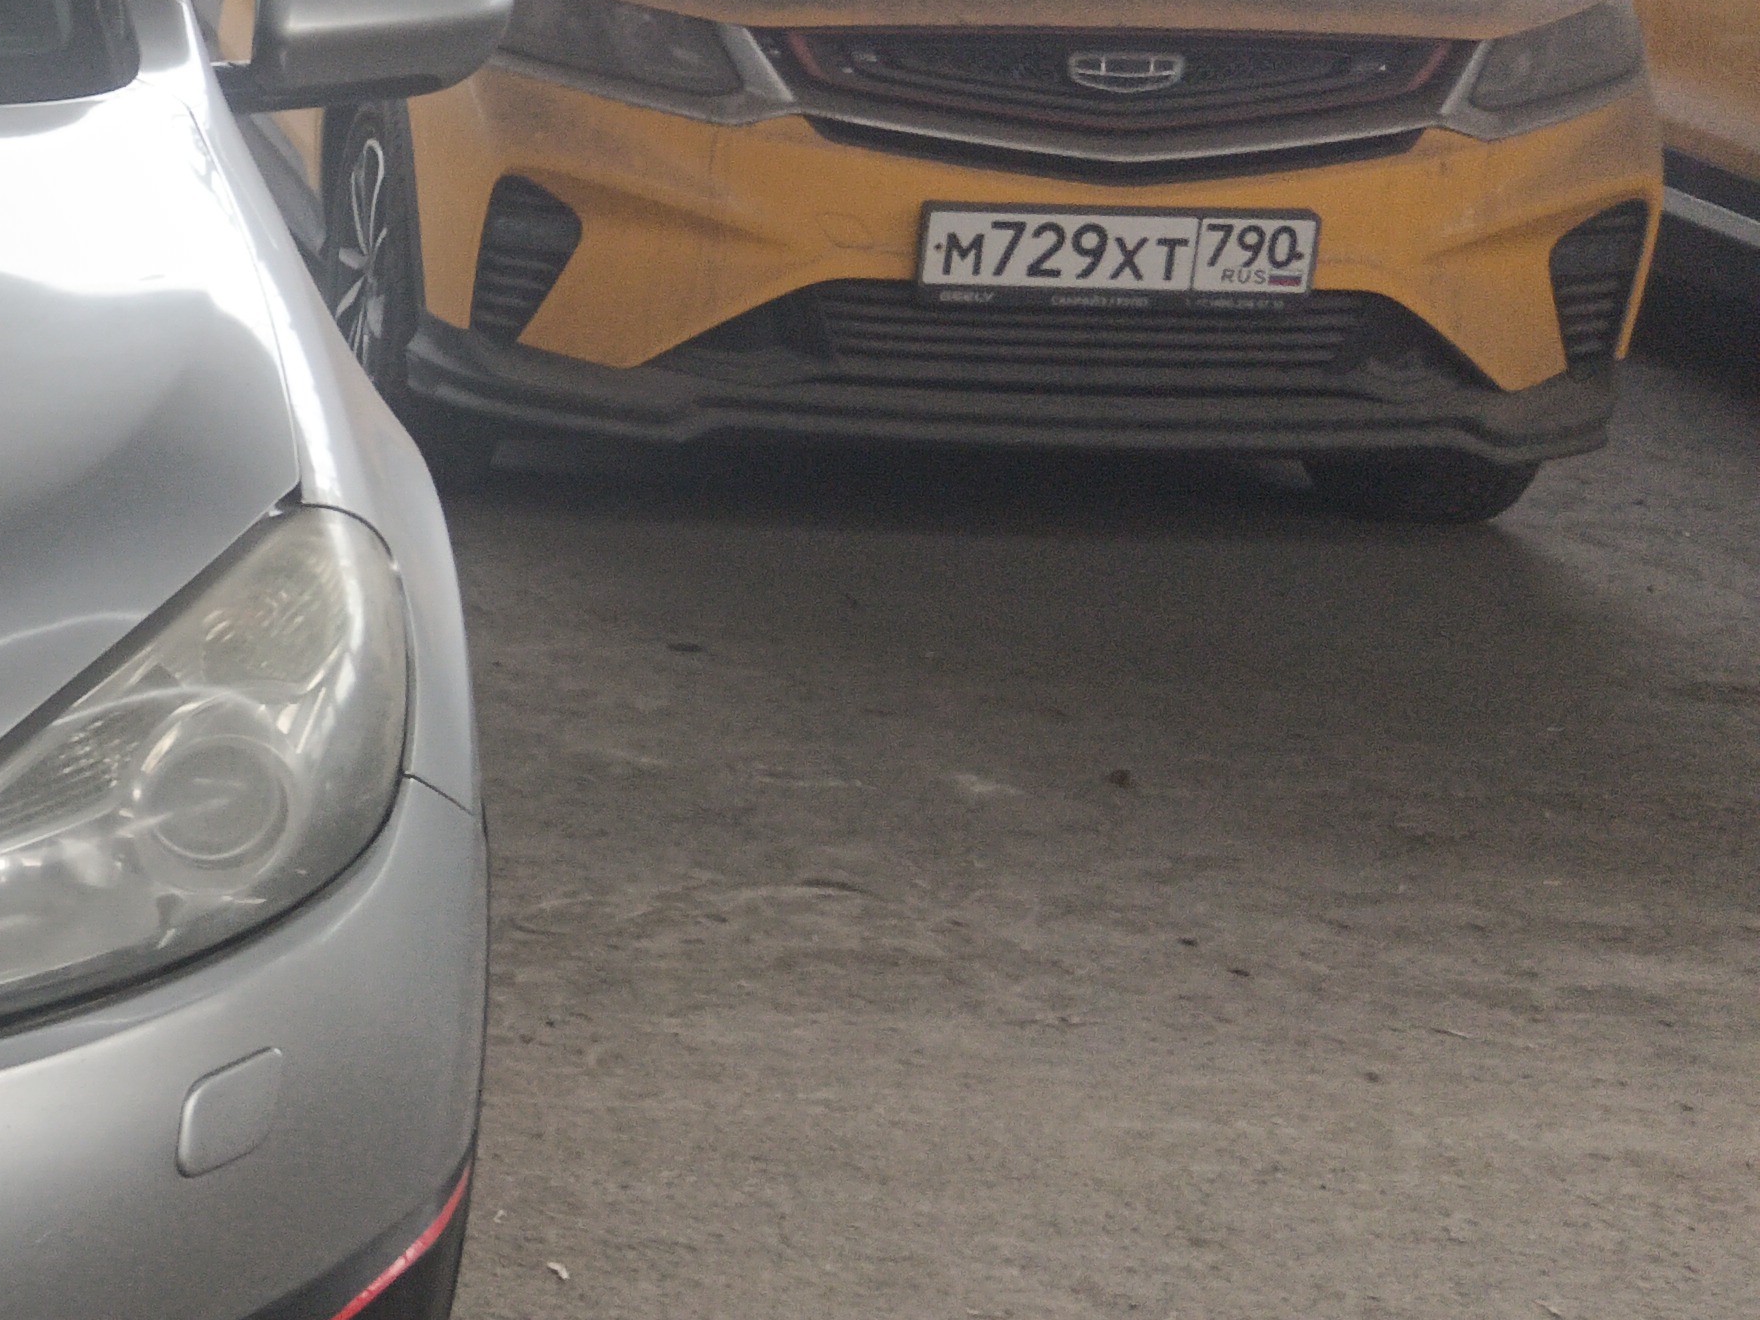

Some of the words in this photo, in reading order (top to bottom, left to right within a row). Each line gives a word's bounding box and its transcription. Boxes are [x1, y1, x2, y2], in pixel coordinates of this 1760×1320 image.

[941, 220, 1189, 282] М729ХТ
[1205, 223, 1298, 270] 790
[1221, 267, 1267, 285] RUS
